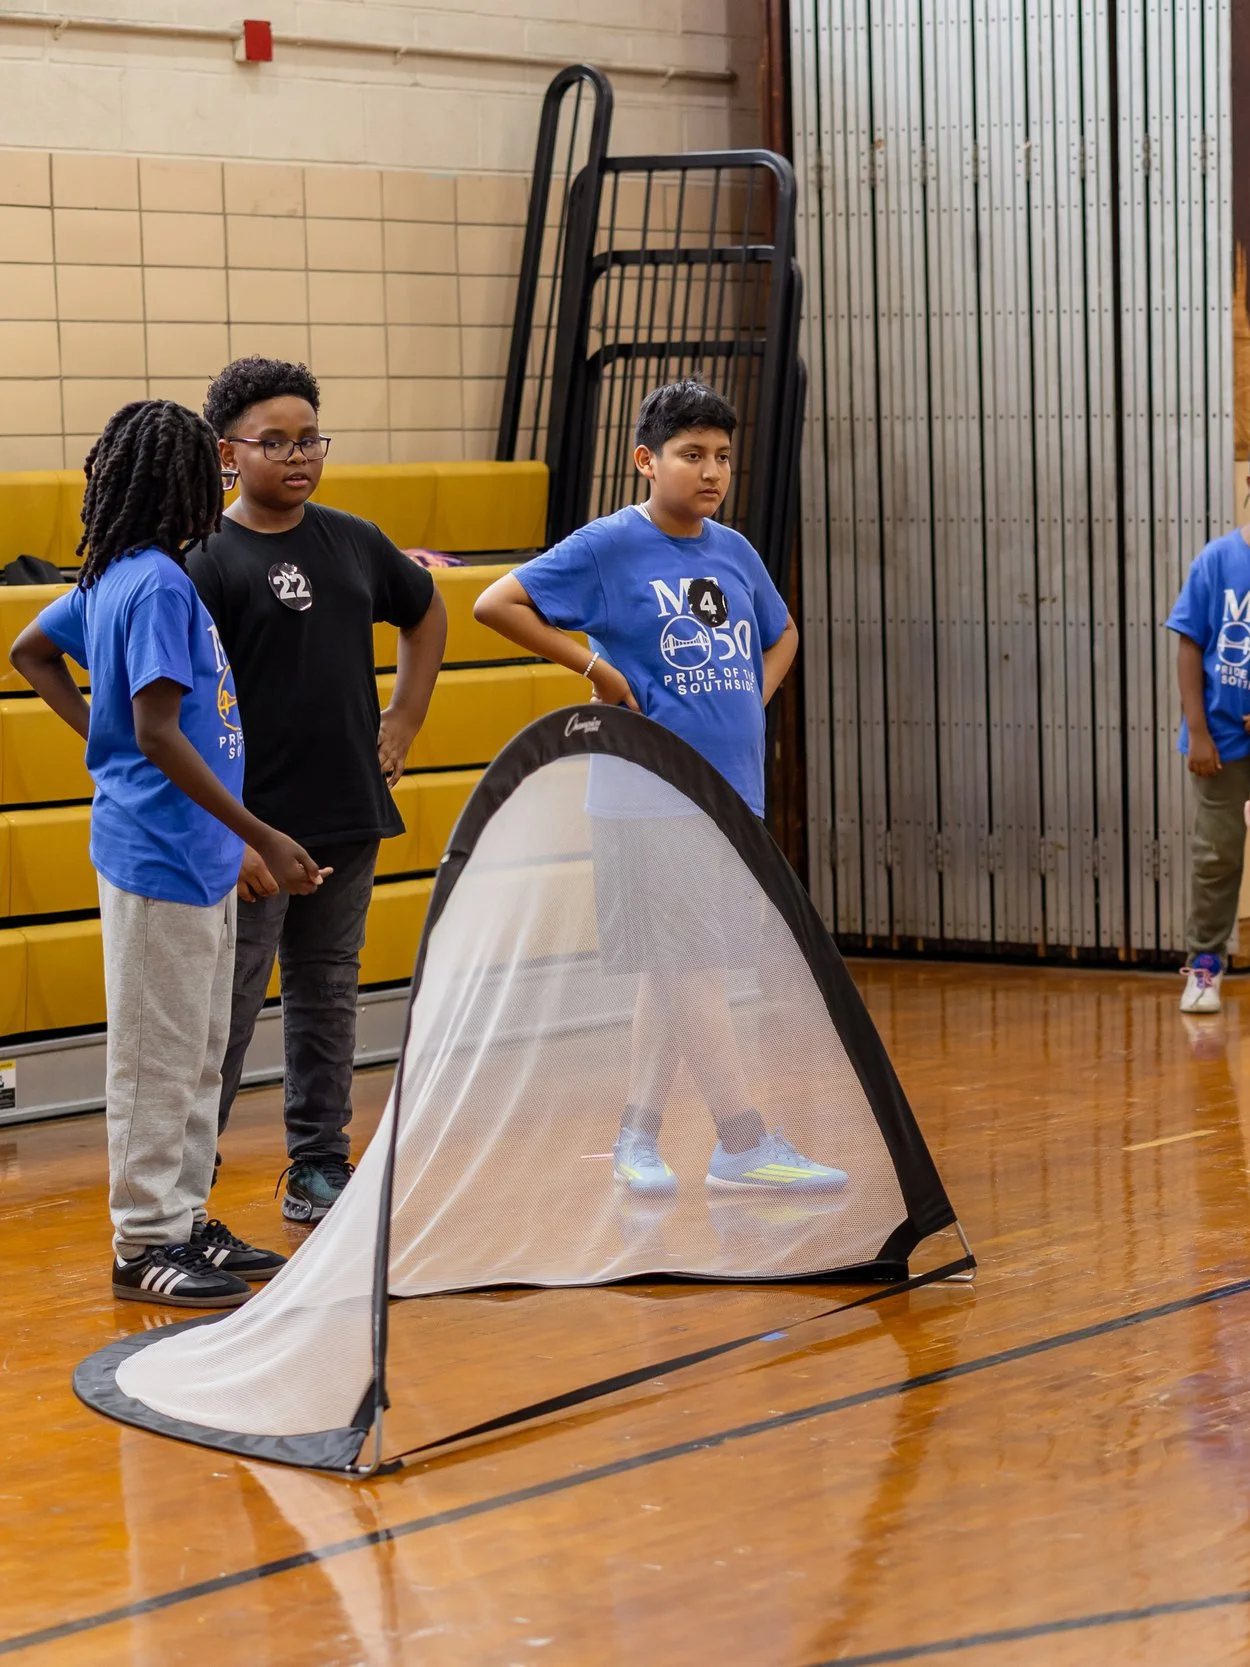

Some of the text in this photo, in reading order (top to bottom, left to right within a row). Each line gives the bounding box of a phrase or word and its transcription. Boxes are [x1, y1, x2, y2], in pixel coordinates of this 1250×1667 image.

[273, 573, 311, 600] 22
[699, 591, 717, 615] 4
[711, 619, 752, 661] 50
[664, 668, 716, 687] PRIDE
[723, 667, 740, 679] OF
[1215, 664, 1248, 680] PRIDE
[678, 679, 755, 696] SOUTHSIDE
